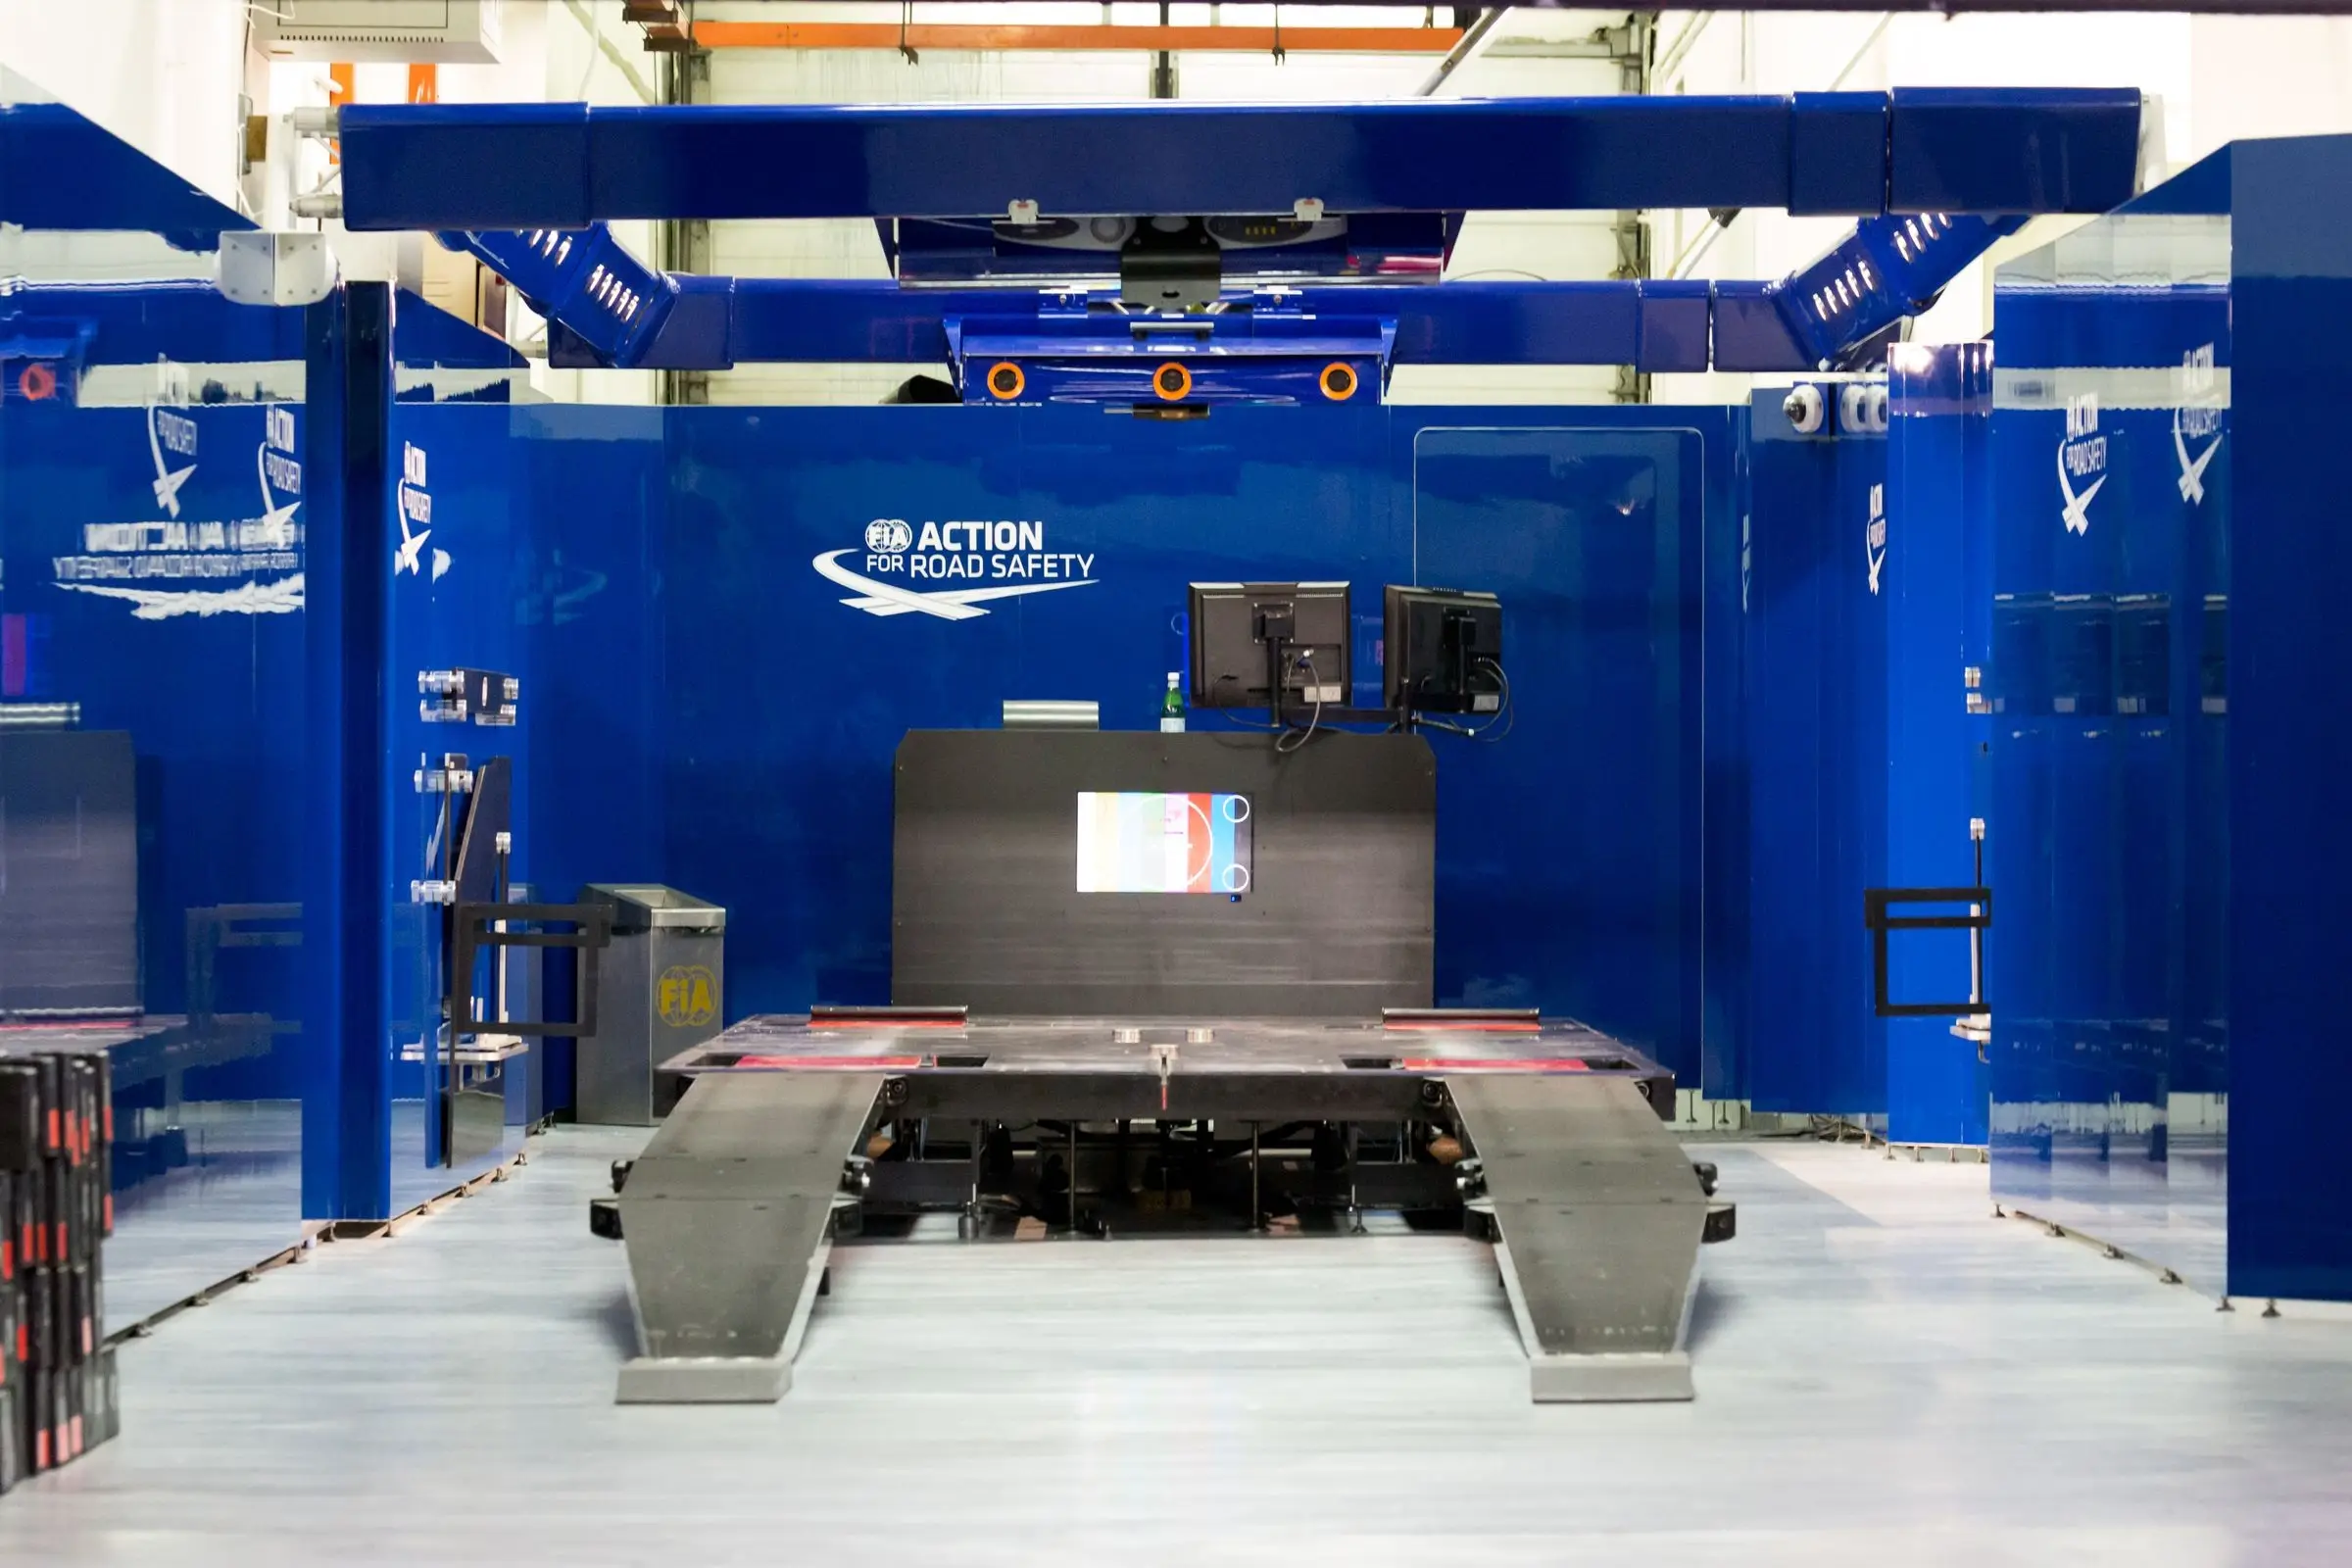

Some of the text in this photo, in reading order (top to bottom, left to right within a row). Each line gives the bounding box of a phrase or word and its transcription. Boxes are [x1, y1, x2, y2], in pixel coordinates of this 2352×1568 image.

[867, 520, 1042, 551] FIA ACTION
[866, 554, 1095, 578] FOR ROAD SAFETY
